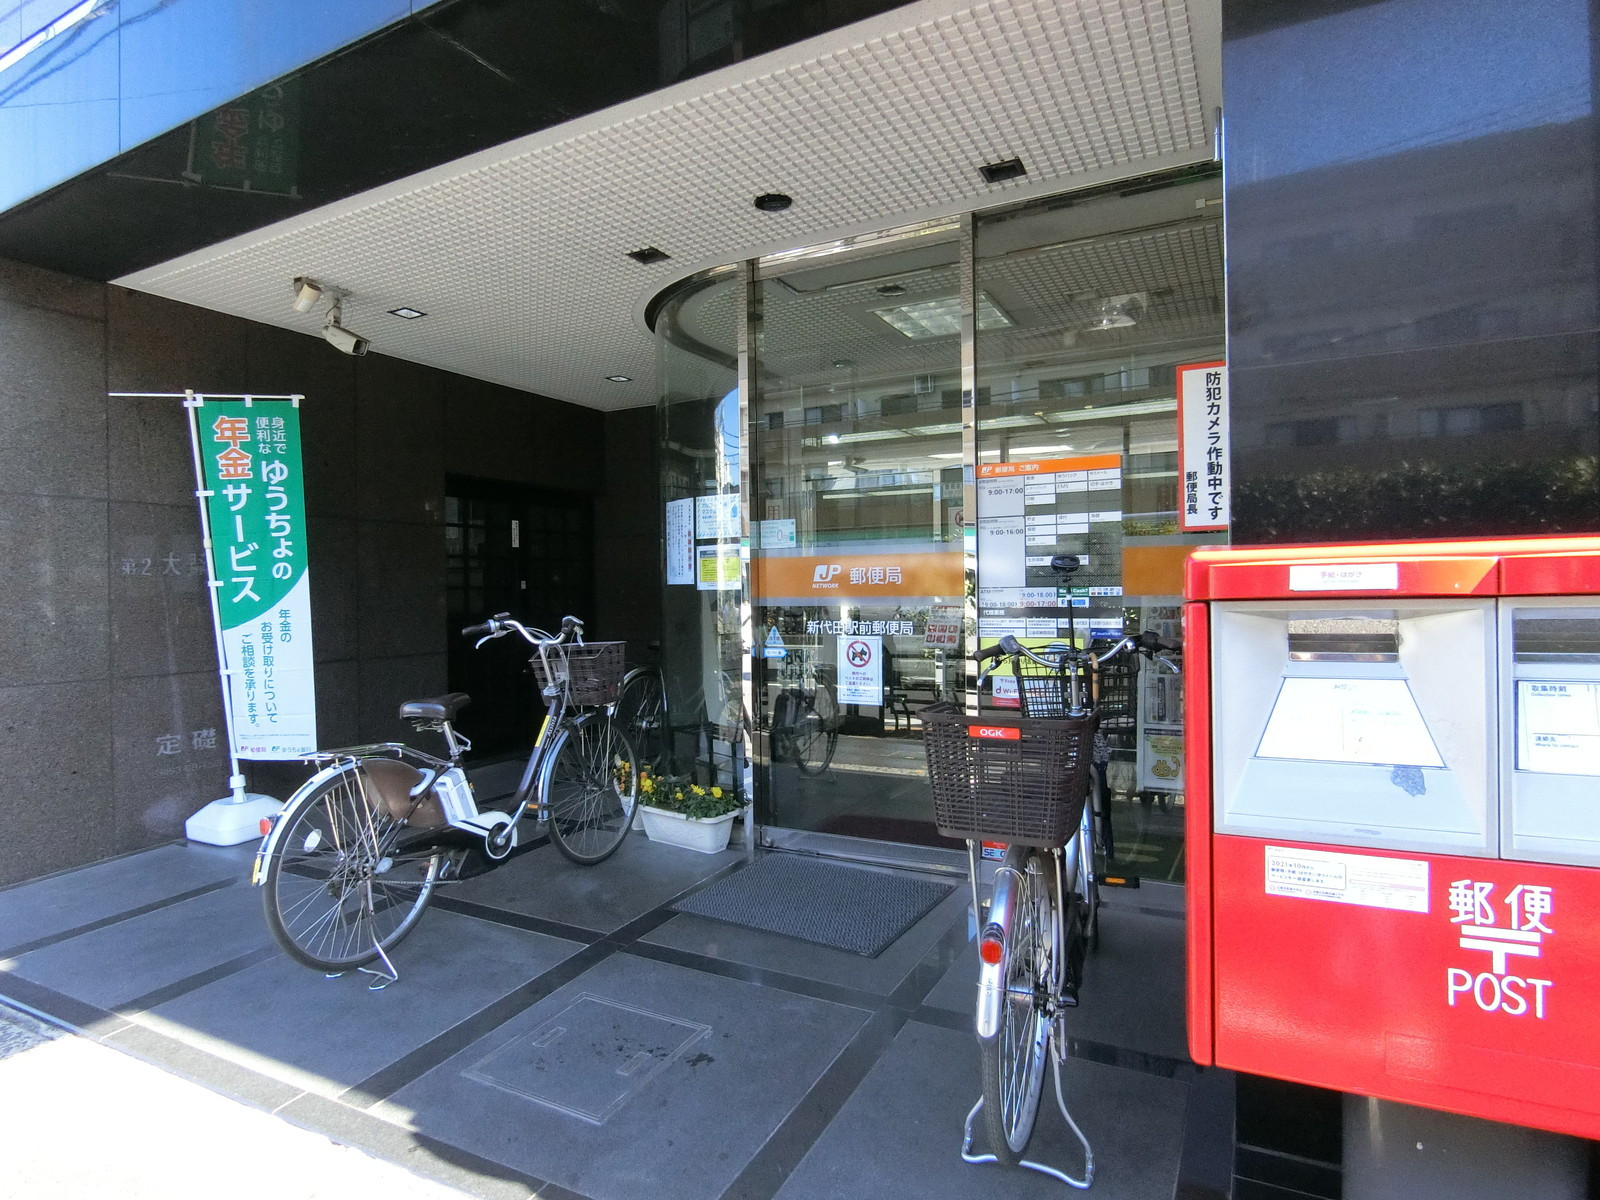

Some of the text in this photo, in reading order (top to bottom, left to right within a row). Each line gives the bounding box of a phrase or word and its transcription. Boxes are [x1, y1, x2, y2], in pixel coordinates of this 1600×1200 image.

[255, 416, 272, 455] 便利な
[271, 416, 287, 455] 身近で
[1206, 372, 1224, 520] 防犯カメラ作動中です
[212, 415, 261, 603] 年金サービス
[988, 487, 1024, 496] 9:00-17:00
[1186, 471, 1198, 515] 郵便局長
[261, 459, 294, 580] ゆうちょの
[989, 528, 1024, 536] 9:00-16:00
[849, 566, 902, 585] 郵便局
[278, 609, 292, 643] 年金の
[806, 620, 914, 636] 新代田駅前郵便局
[240, 633, 261, 728] ご相談を承ります。
[260, 622, 278, 724] お受け取りについて
[979, 728, 1003, 737] OGK
[1448, 879, 1553, 934] 郵便
[1447, 967, 1553, 1019] POST
